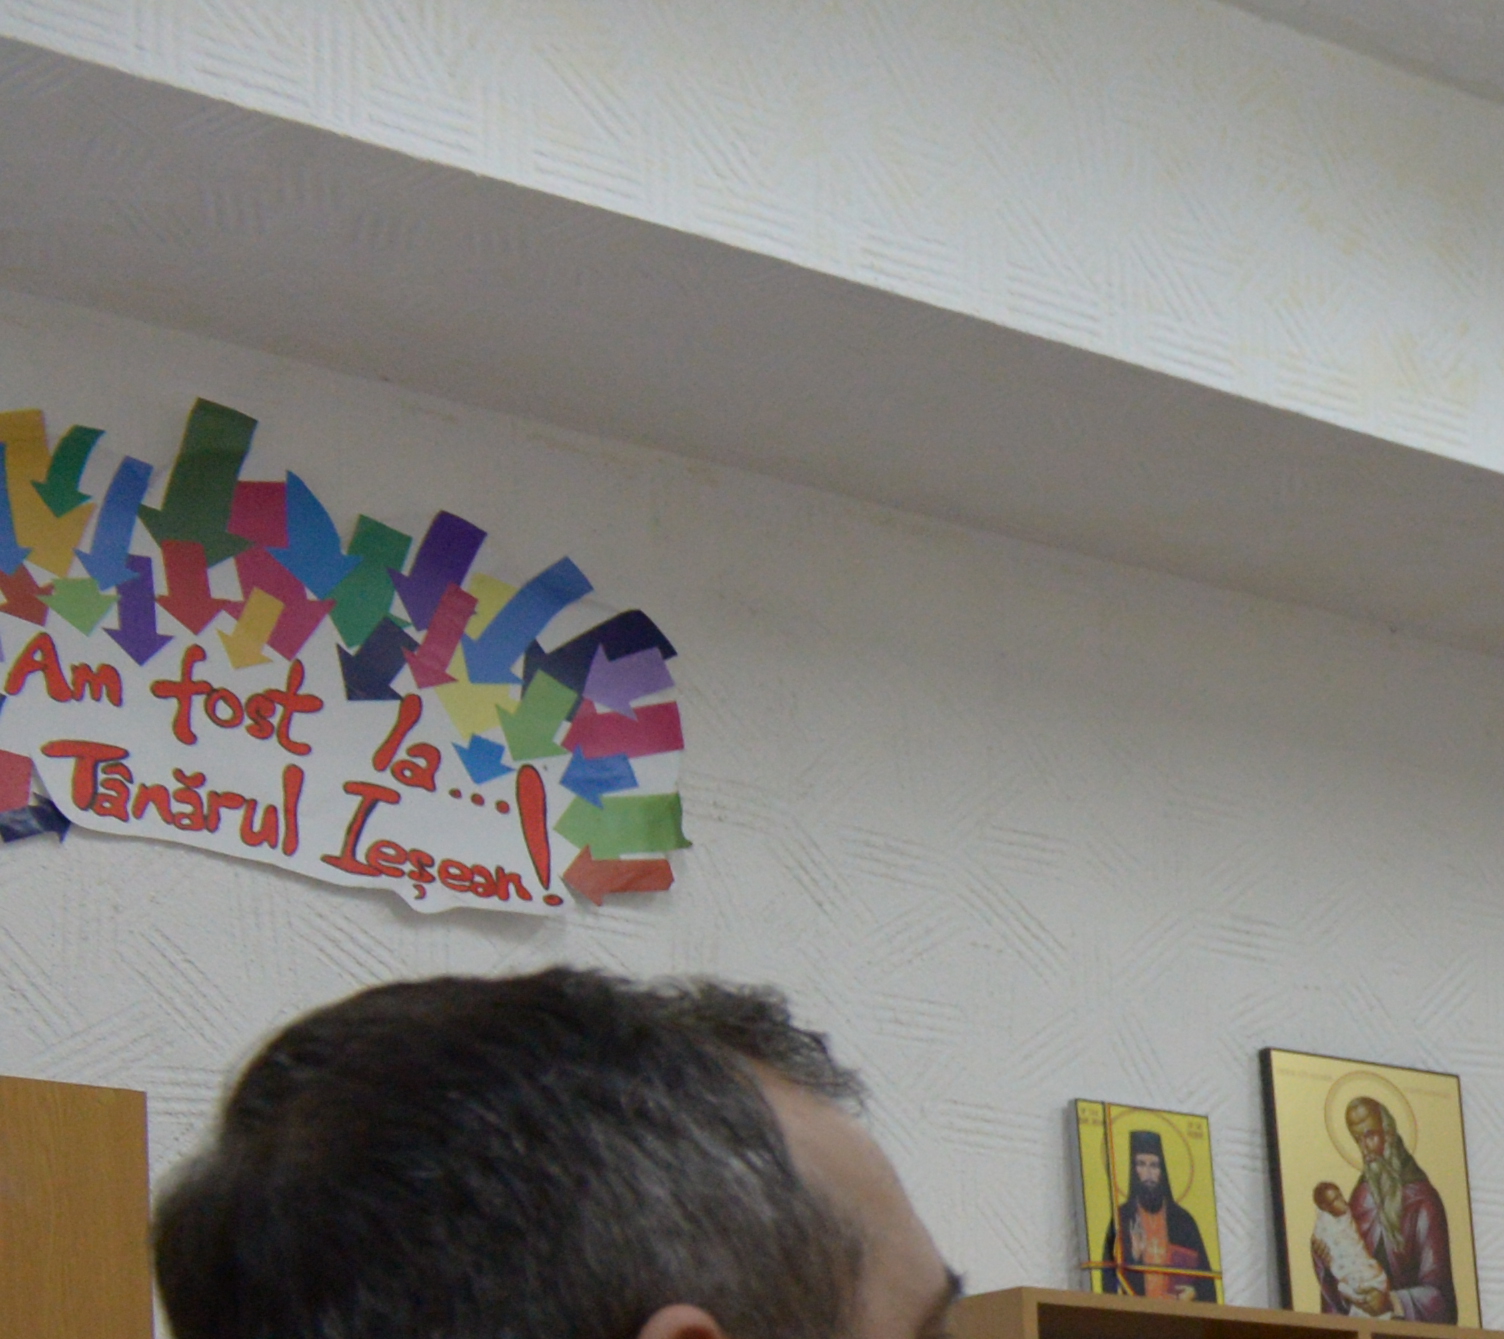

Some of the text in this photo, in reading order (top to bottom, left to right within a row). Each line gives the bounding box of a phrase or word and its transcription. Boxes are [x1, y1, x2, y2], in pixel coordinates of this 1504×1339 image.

[4, 631, 123, 707] Am
[149, 643, 324, 756] fost
[40, 739, 304, 857] Tânărul
